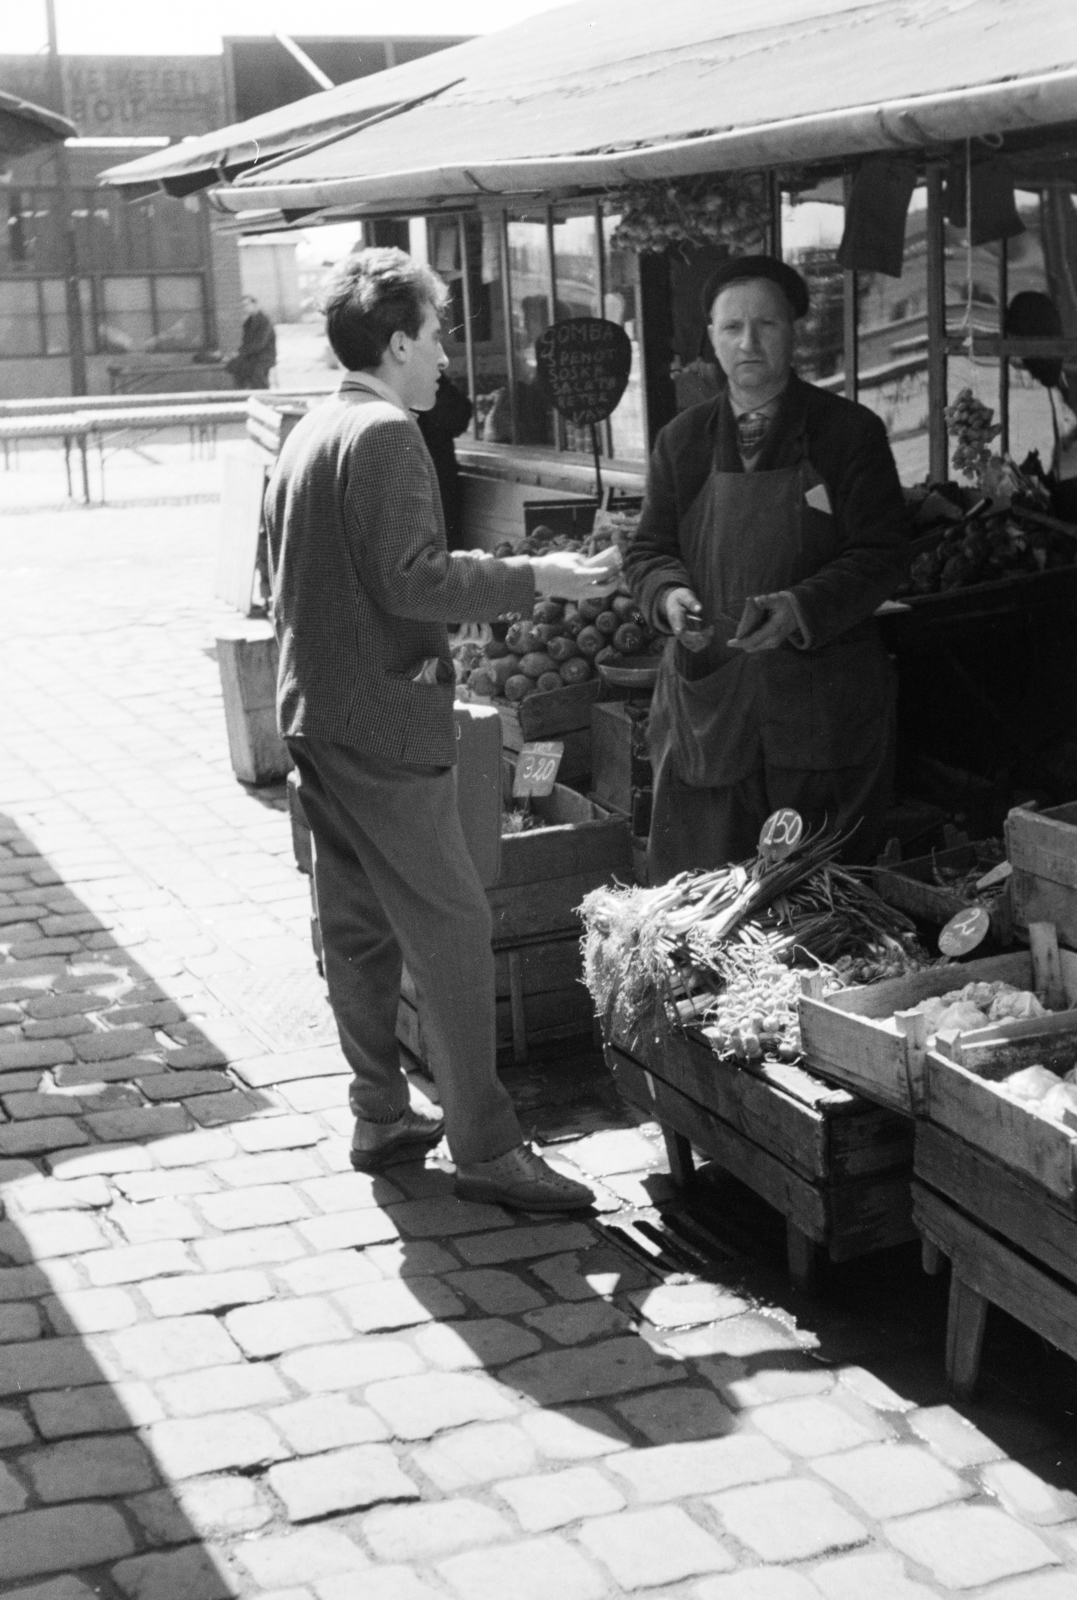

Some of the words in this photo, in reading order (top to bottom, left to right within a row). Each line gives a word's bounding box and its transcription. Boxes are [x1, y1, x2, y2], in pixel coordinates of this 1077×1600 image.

[522, 756, 556, 781] 320
[763, 810, 803, 845] 150
[953, 909, 981, 935] 2
